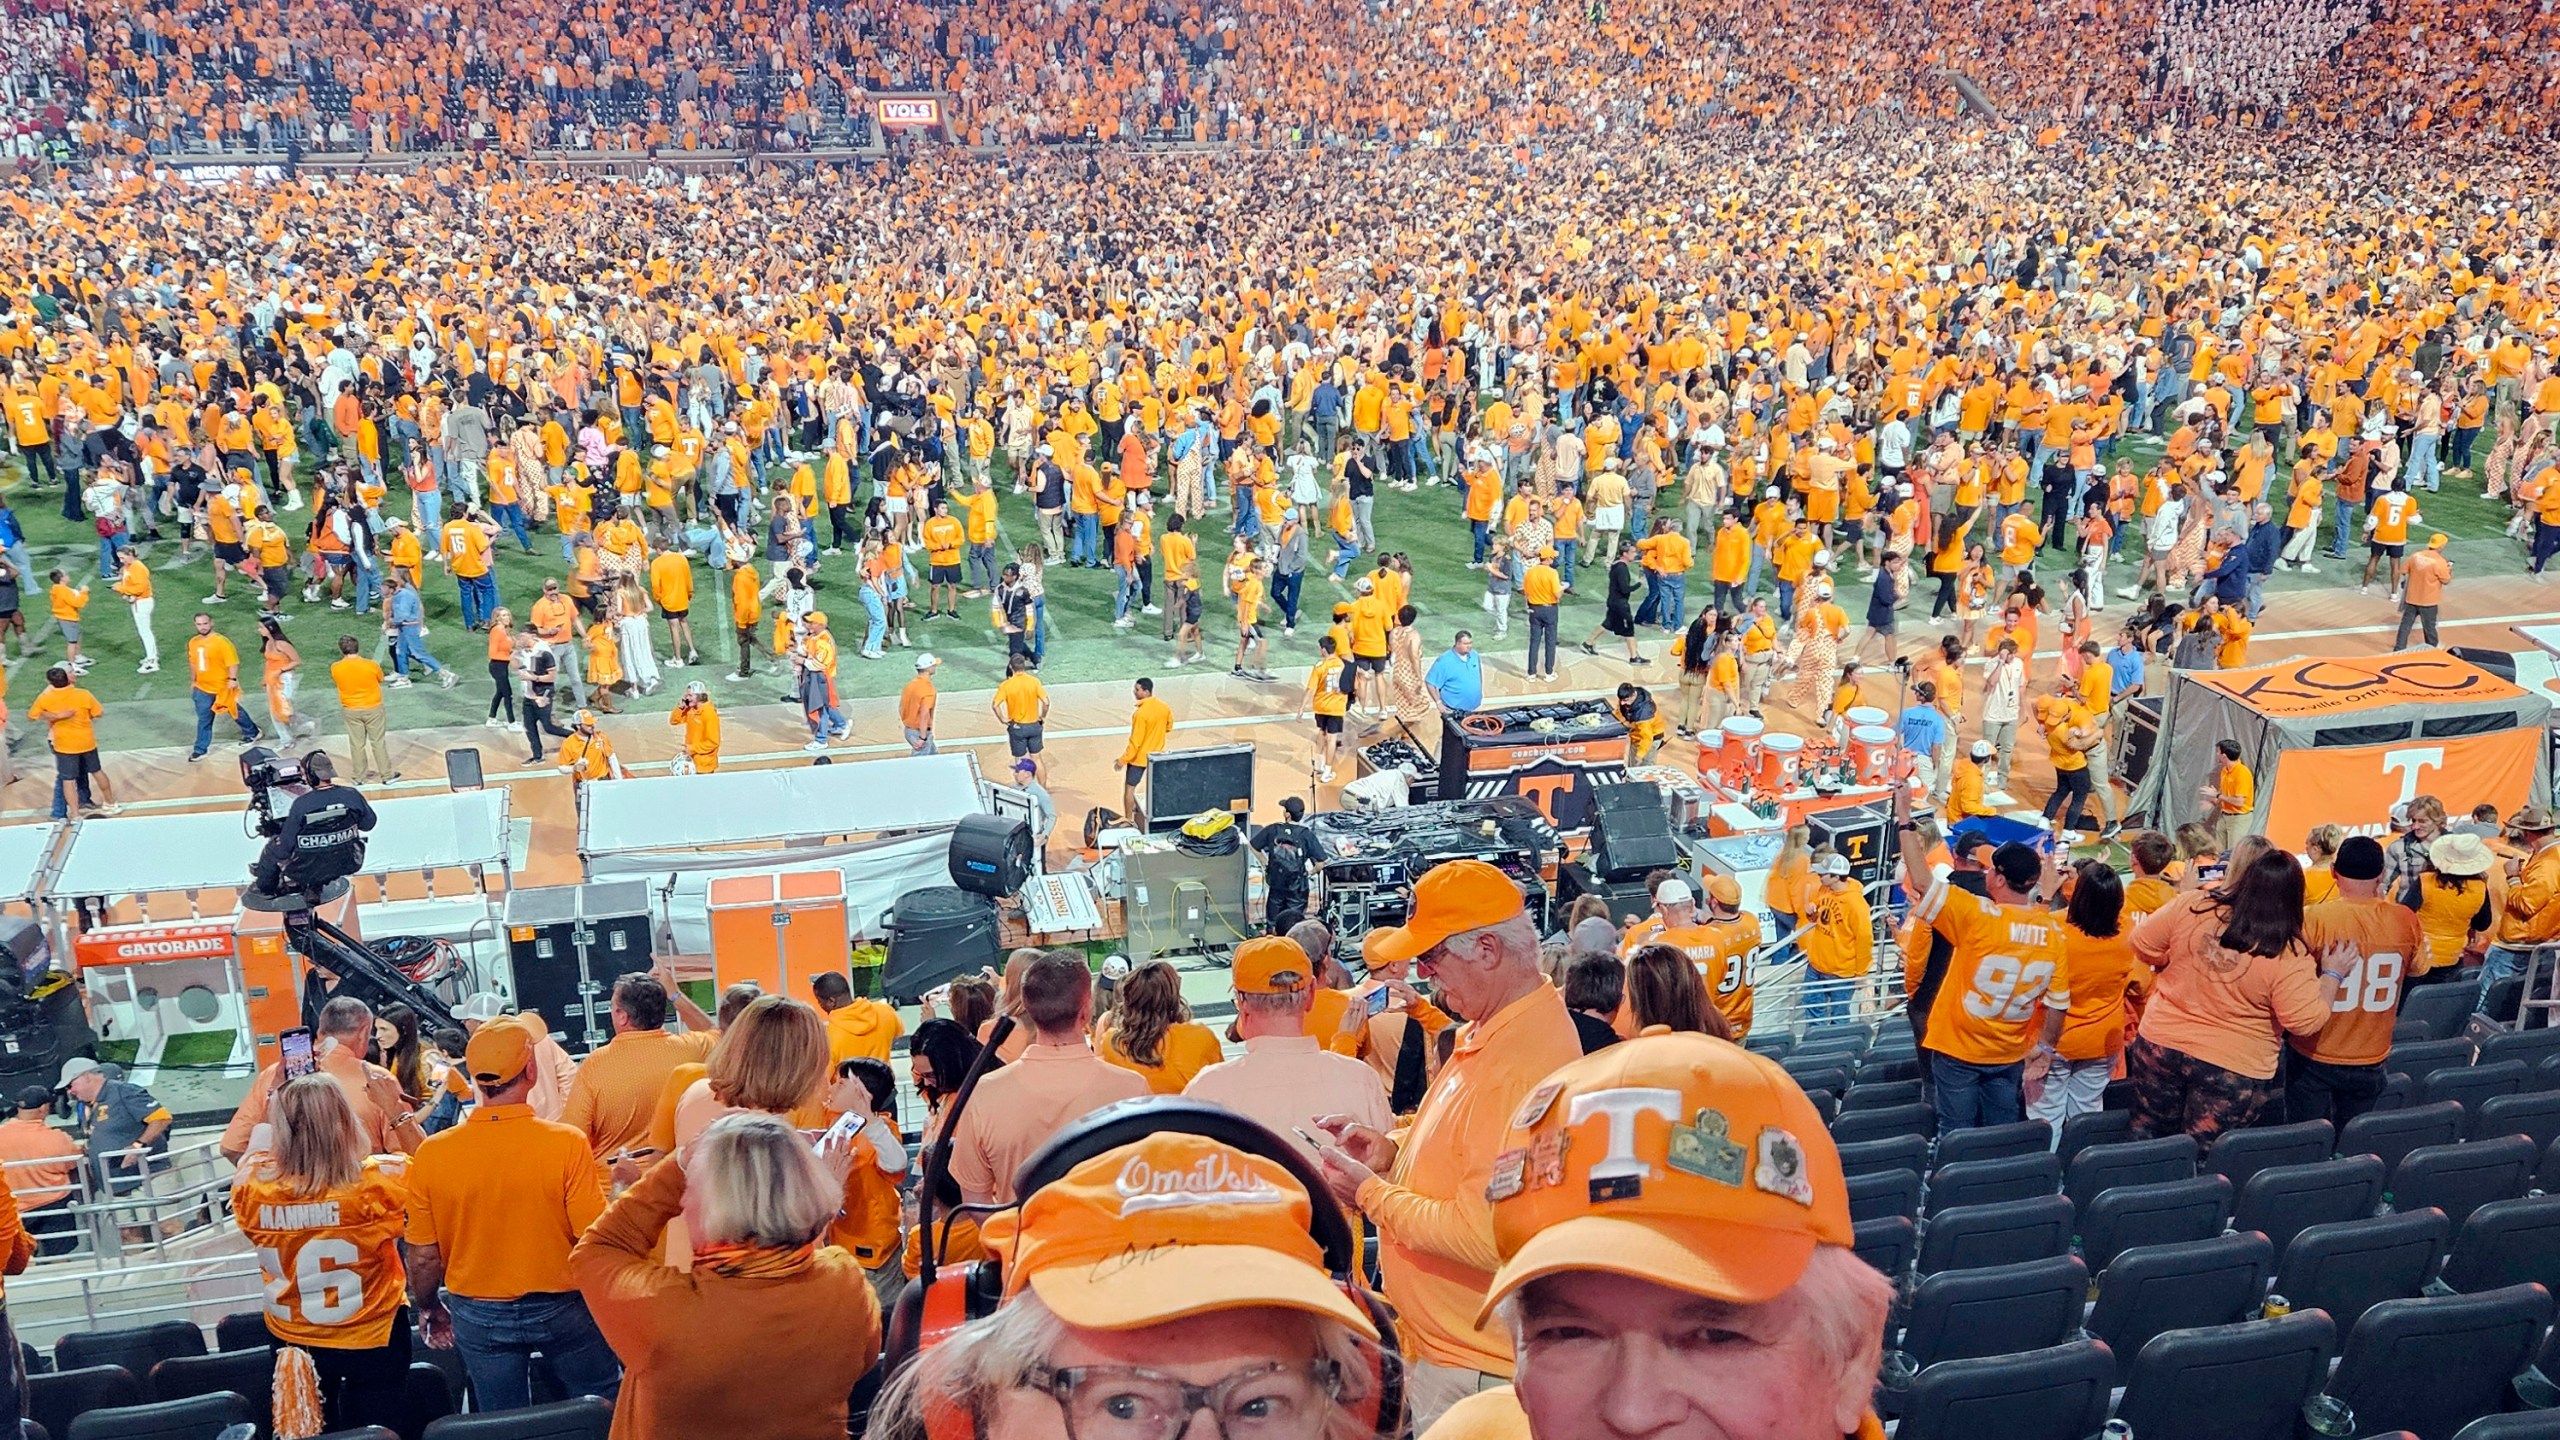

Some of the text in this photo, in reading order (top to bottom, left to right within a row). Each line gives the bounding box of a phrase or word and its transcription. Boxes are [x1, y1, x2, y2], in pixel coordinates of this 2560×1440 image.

[886, 103, 930, 118] VOLS
[682, 438, 698, 456] T
[2388, 506, 2402, 526] 6
[197, 646, 204, 672] 1
[2210, 662, 2479, 705] KOC
[1512, 746, 1587, 759] coachcomm.com
[1782, 757, 1798, 773] G
[1871, 749, 1886, 765] G
[2382, 747, 2445, 813] T
[1519, 773, 1574, 827] T
[300, 828, 358, 846] CHAPMA
[1848, 834, 1869, 859] T
[1046, 880, 1070, 917] TENNESSEE
[2009, 922, 2049, 946] WHITE
[118, 938, 224, 957] GATORADE
[1717, 946, 1760, 994] 98
[1964, 955, 2055, 1021] 92
[1568, 1087, 1682, 1178] T
[260, 1201, 340, 1230] MANNING
[258, 1238, 363, 1325] 16
